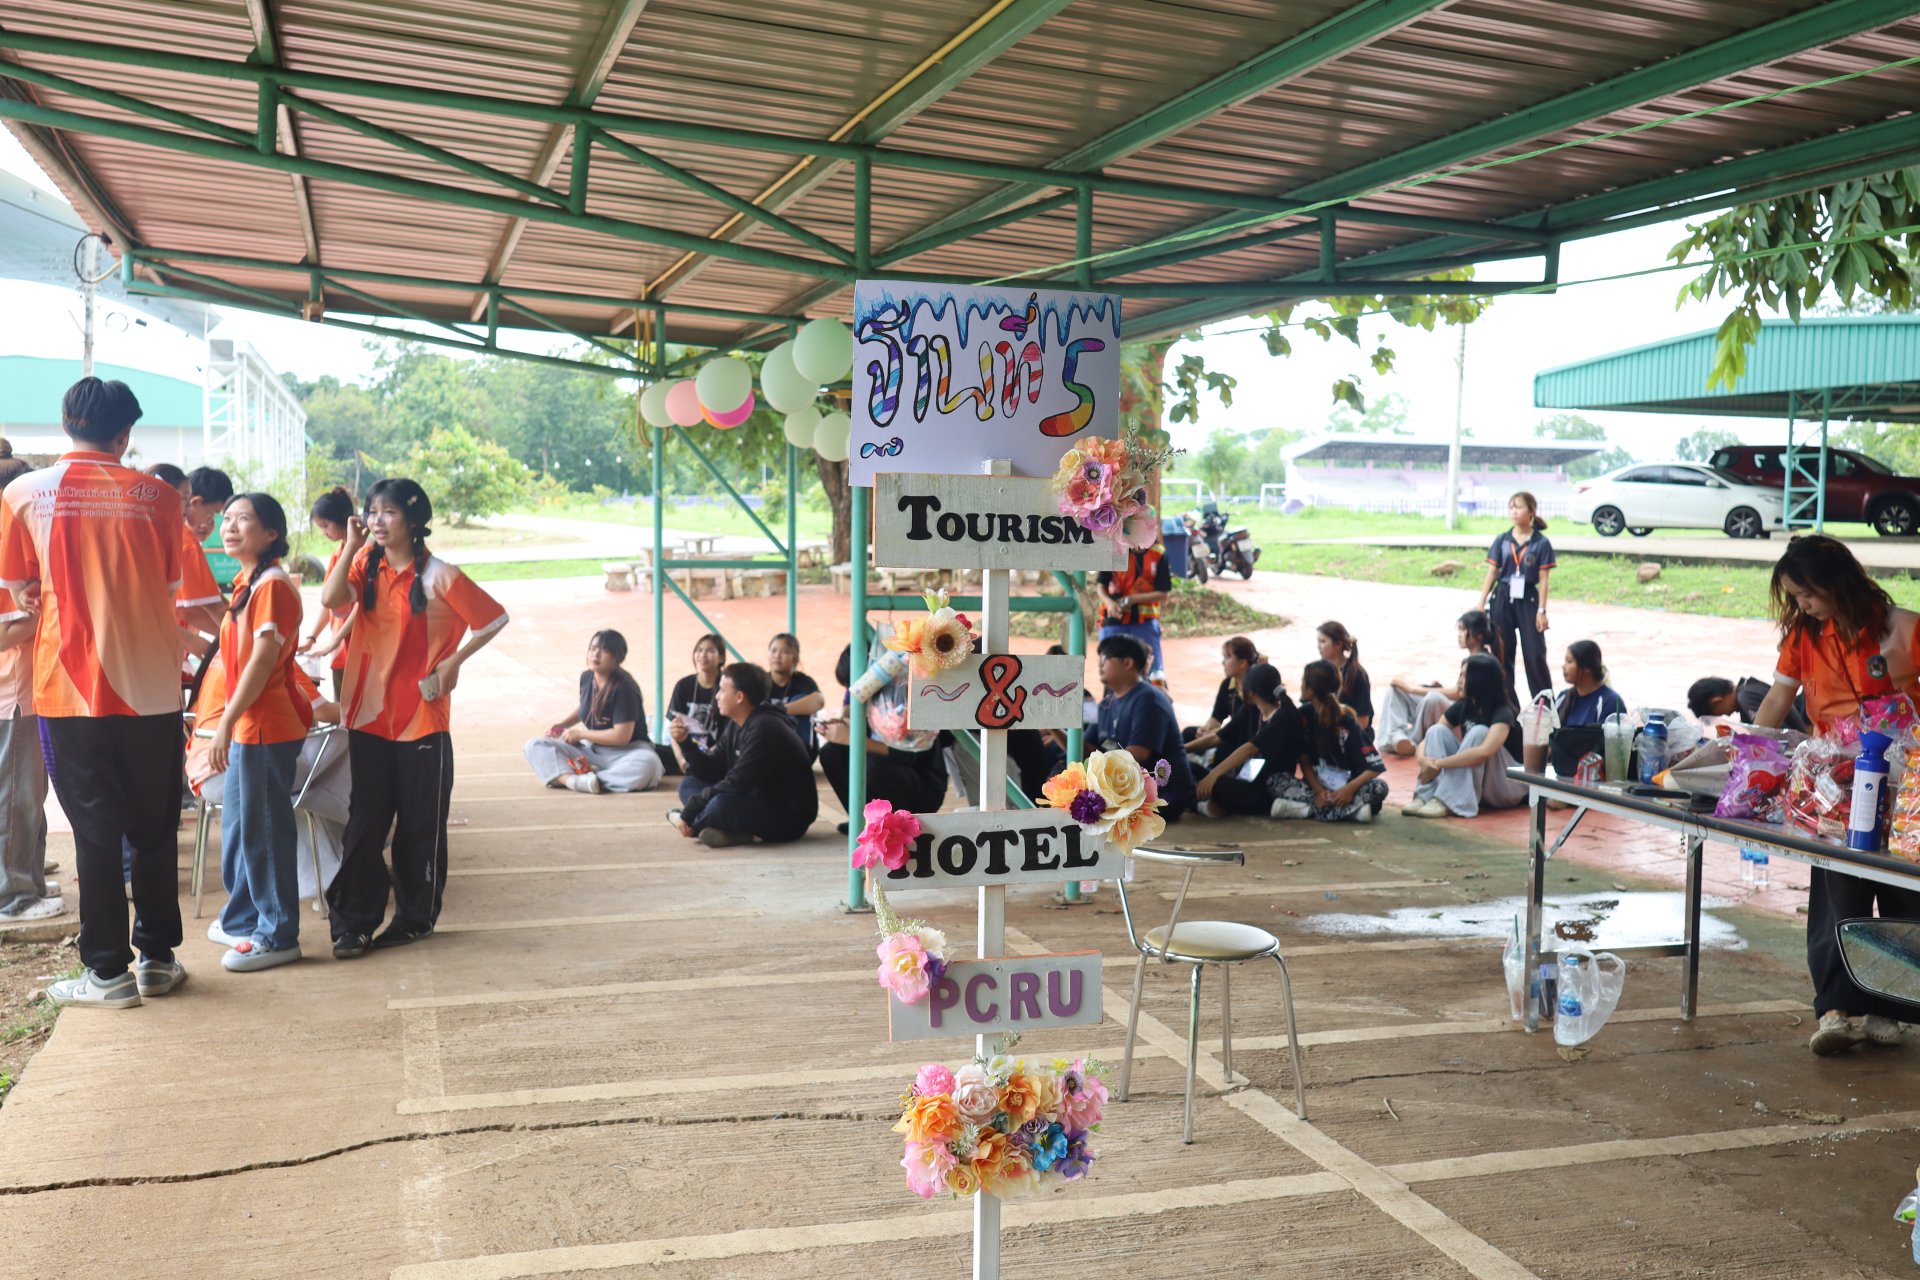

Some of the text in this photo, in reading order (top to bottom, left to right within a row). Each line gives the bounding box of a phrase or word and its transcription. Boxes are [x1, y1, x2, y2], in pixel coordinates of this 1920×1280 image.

[127, 481, 159, 501] 49
[975, 654, 1028, 729] &
[887, 824, 1099, 879] HOTEL
[929, 969, 1083, 1028] PCRU
